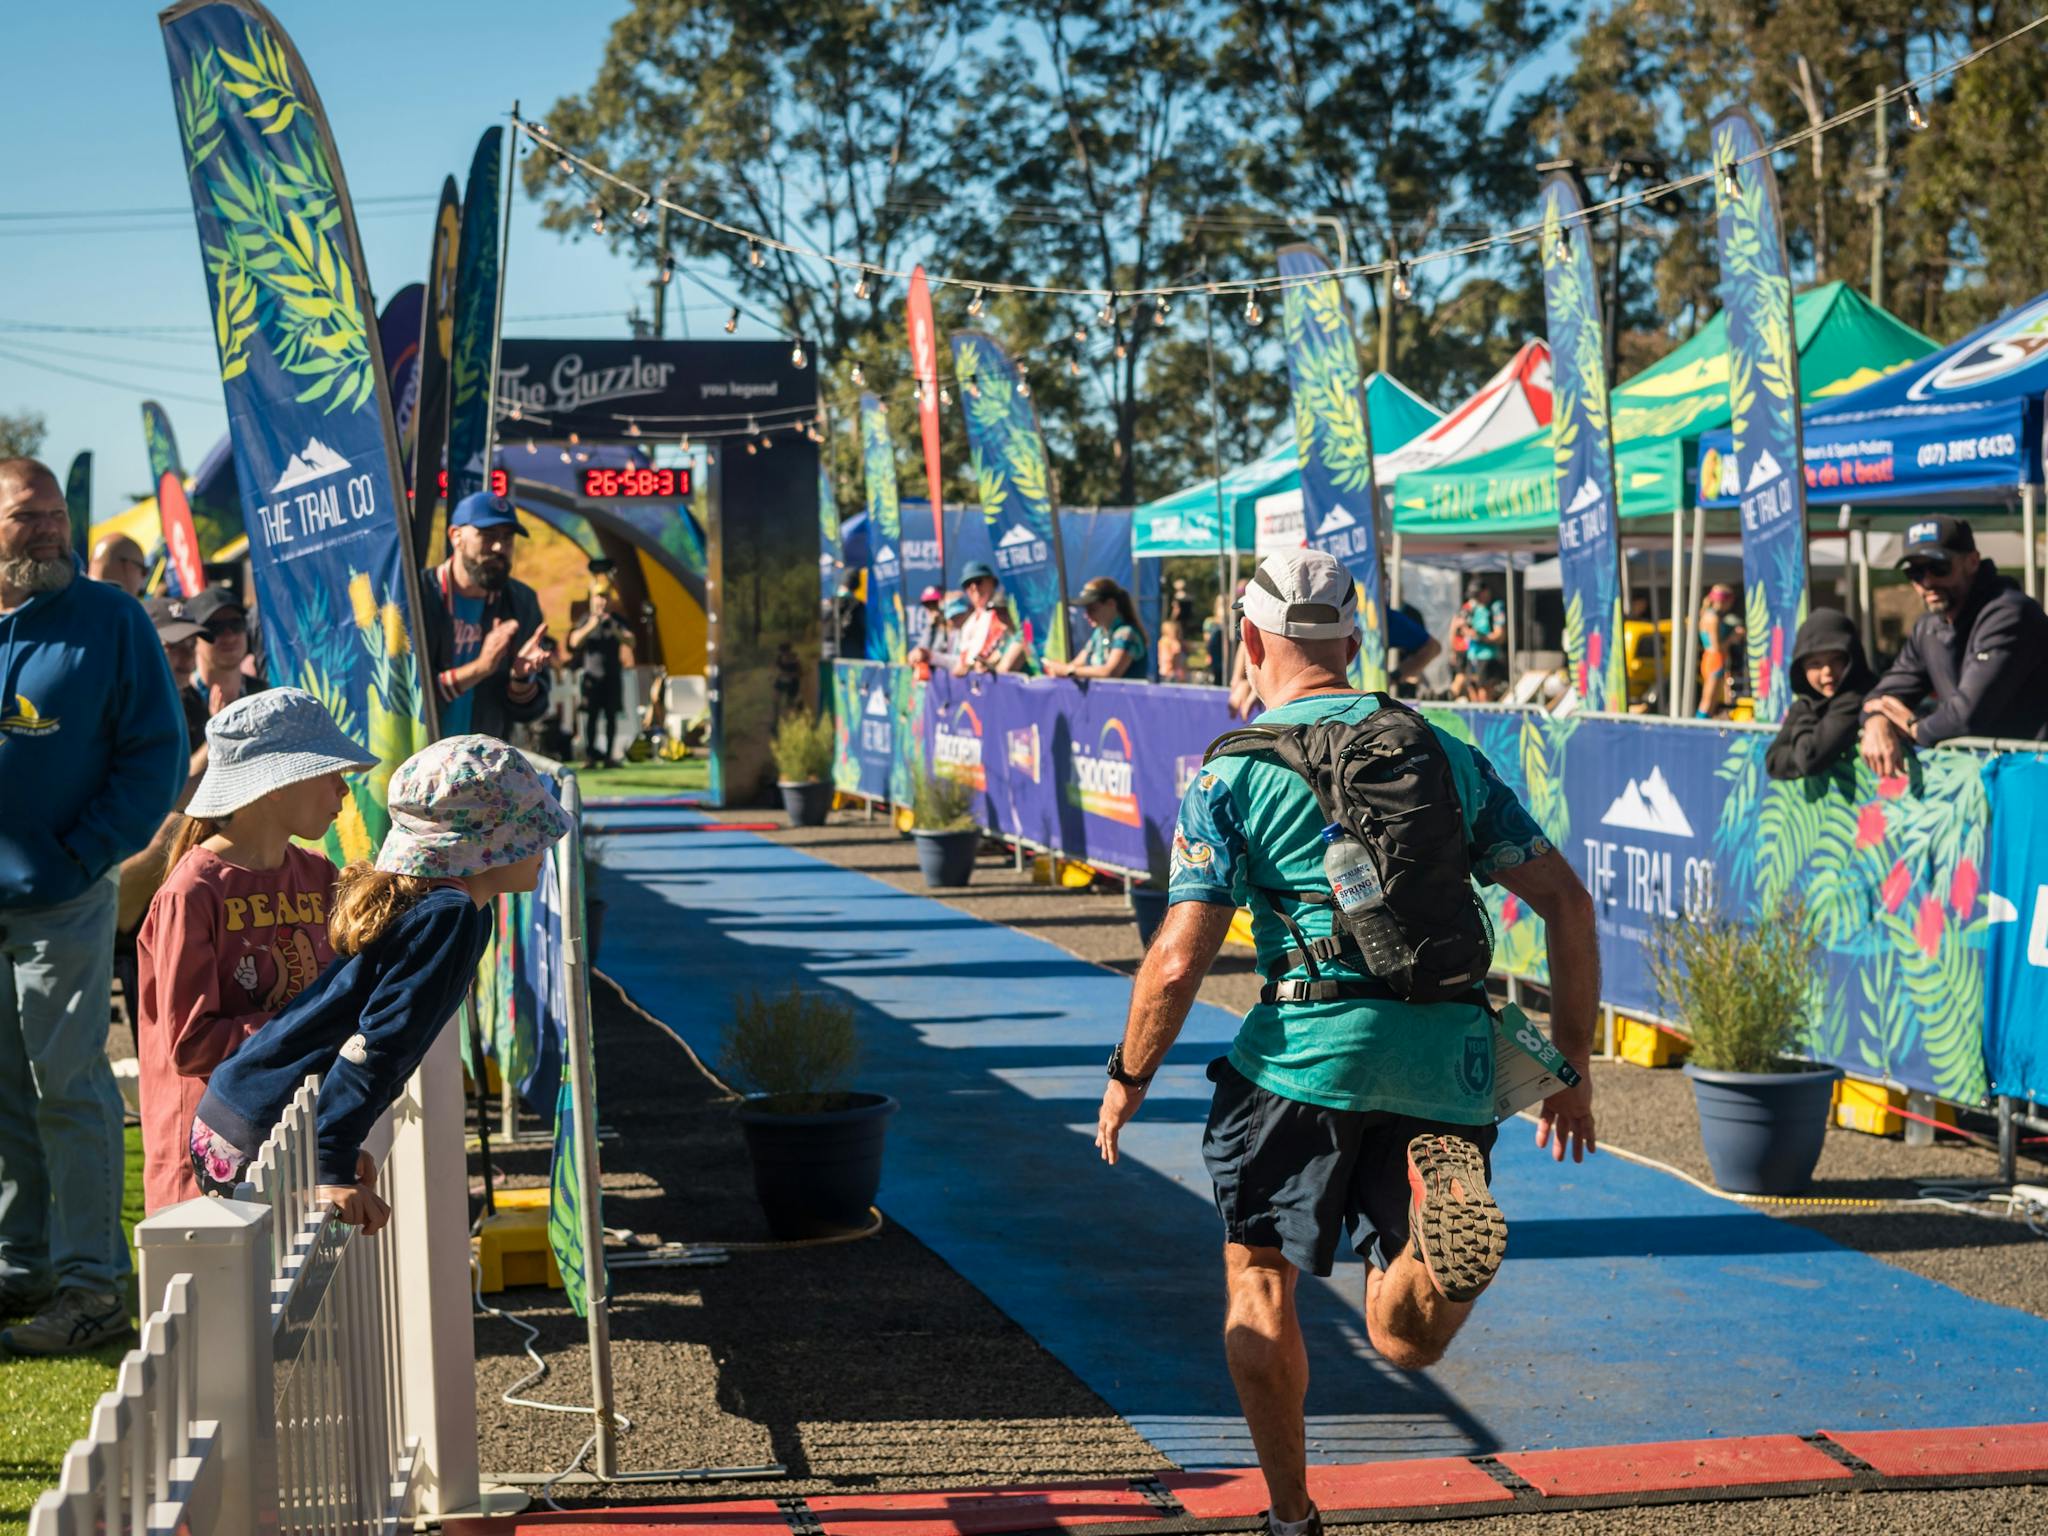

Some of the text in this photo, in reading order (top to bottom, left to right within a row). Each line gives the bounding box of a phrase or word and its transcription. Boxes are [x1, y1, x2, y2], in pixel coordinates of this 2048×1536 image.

[498, 354, 675, 412] The Guzzler
[701, 380, 778, 399] you legend
[258, 500, 294, 547] THE
[294, 485, 348, 536] TRAIL
[347, 474, 375, 519] CO
[1339, 880, 1372, 899] SPRING
[1343, 886, 1376, 905] WATER
[1583, 838, 1713, 924] THE TRAIL CO
[223, 891, 324, 931] PEACE
[1471, 1056, 1484, 1083] 4
